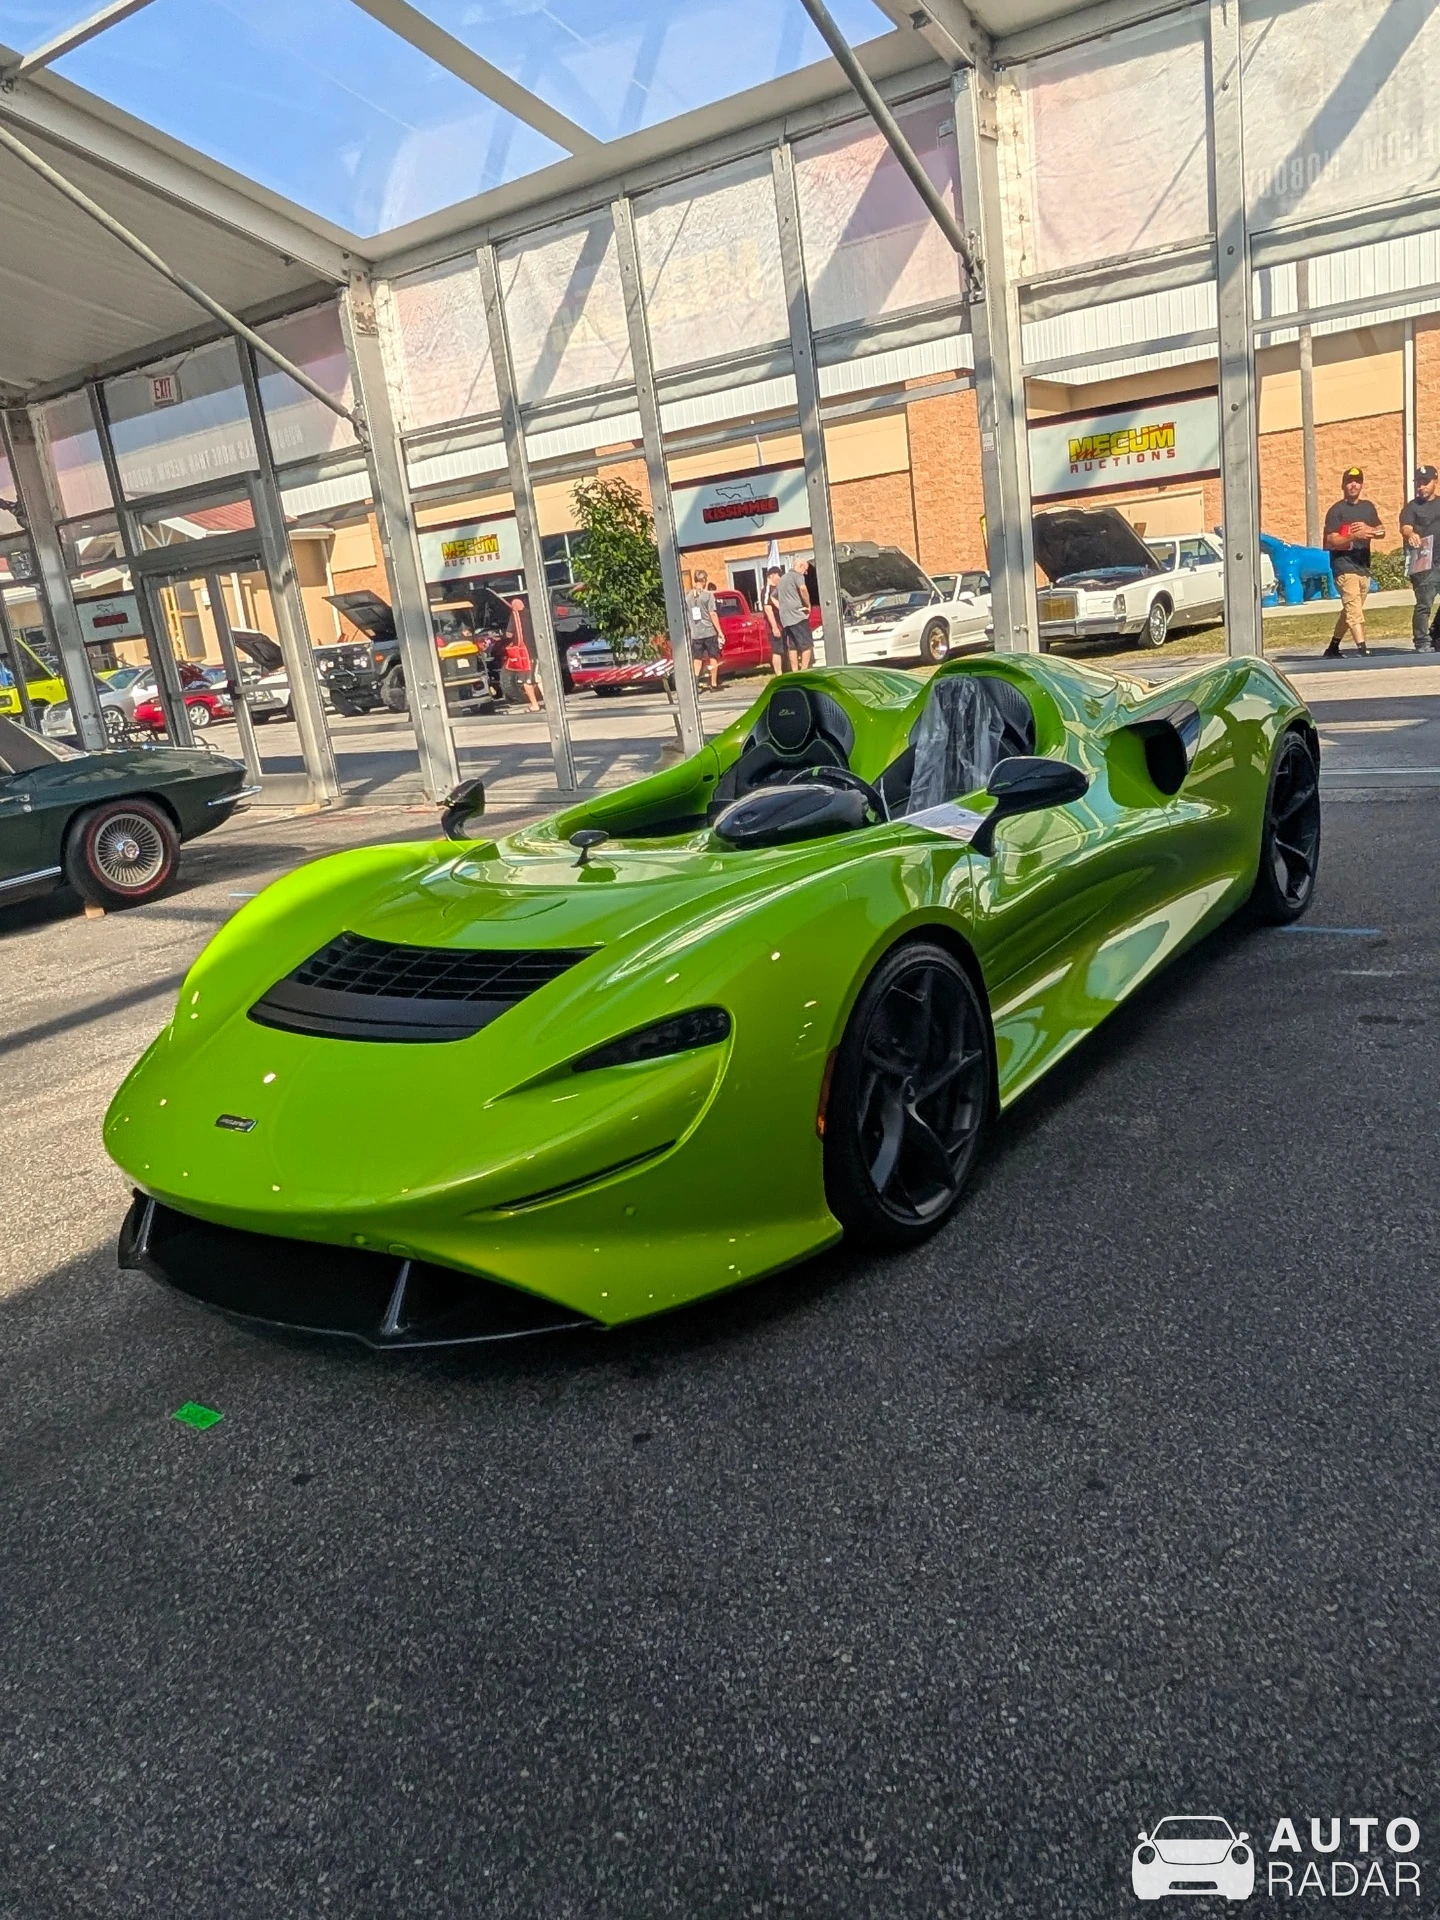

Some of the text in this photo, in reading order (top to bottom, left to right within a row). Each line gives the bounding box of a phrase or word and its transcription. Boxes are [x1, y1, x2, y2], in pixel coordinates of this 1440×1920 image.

[153, 377, 172, 399] EXIT
[1069, 421, 1176, 463] MECUM
[1070, 449, 1176, 474] AUCTIONS
[703, 497, 779, 524] KISSIMMEE
[441, 534, 499, 560] MECUM
[444, 553, 500, 567] AUCTIONS
